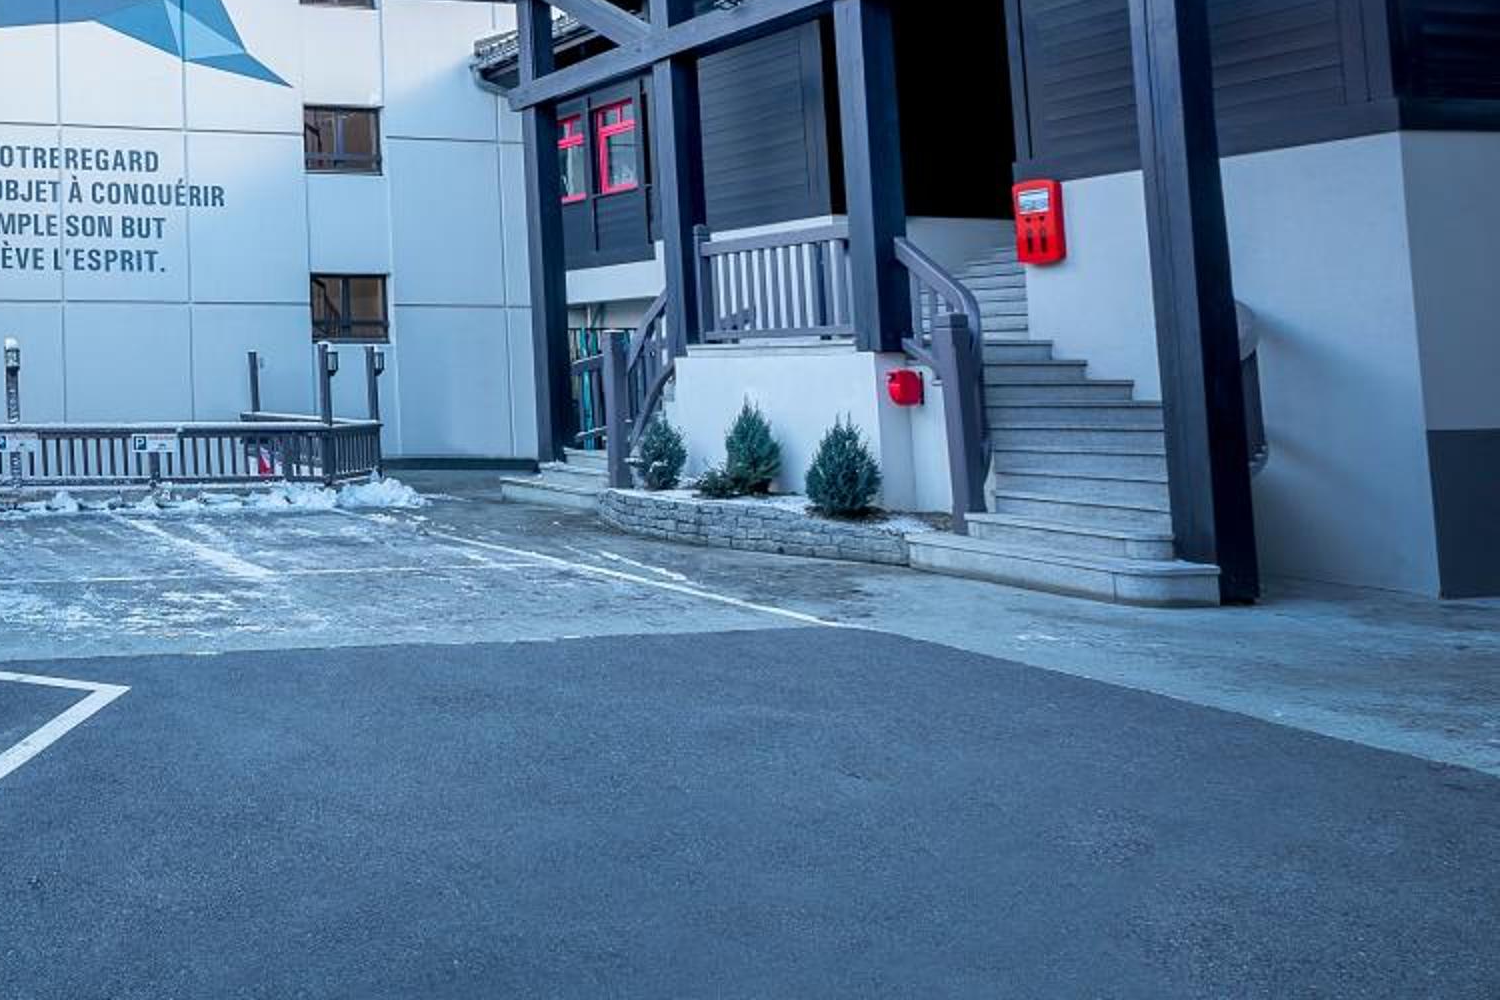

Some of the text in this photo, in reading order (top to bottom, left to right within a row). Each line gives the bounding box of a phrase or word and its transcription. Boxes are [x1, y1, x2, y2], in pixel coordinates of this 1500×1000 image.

[68, 176, 83, 203] À
[91, 178, 226, 207] CONQUÉRIR
[65, 215, 114, 239] SON
[121, 216, 166, 239] BUT
[53, 249, 166, 273] L'ESPRIT.
